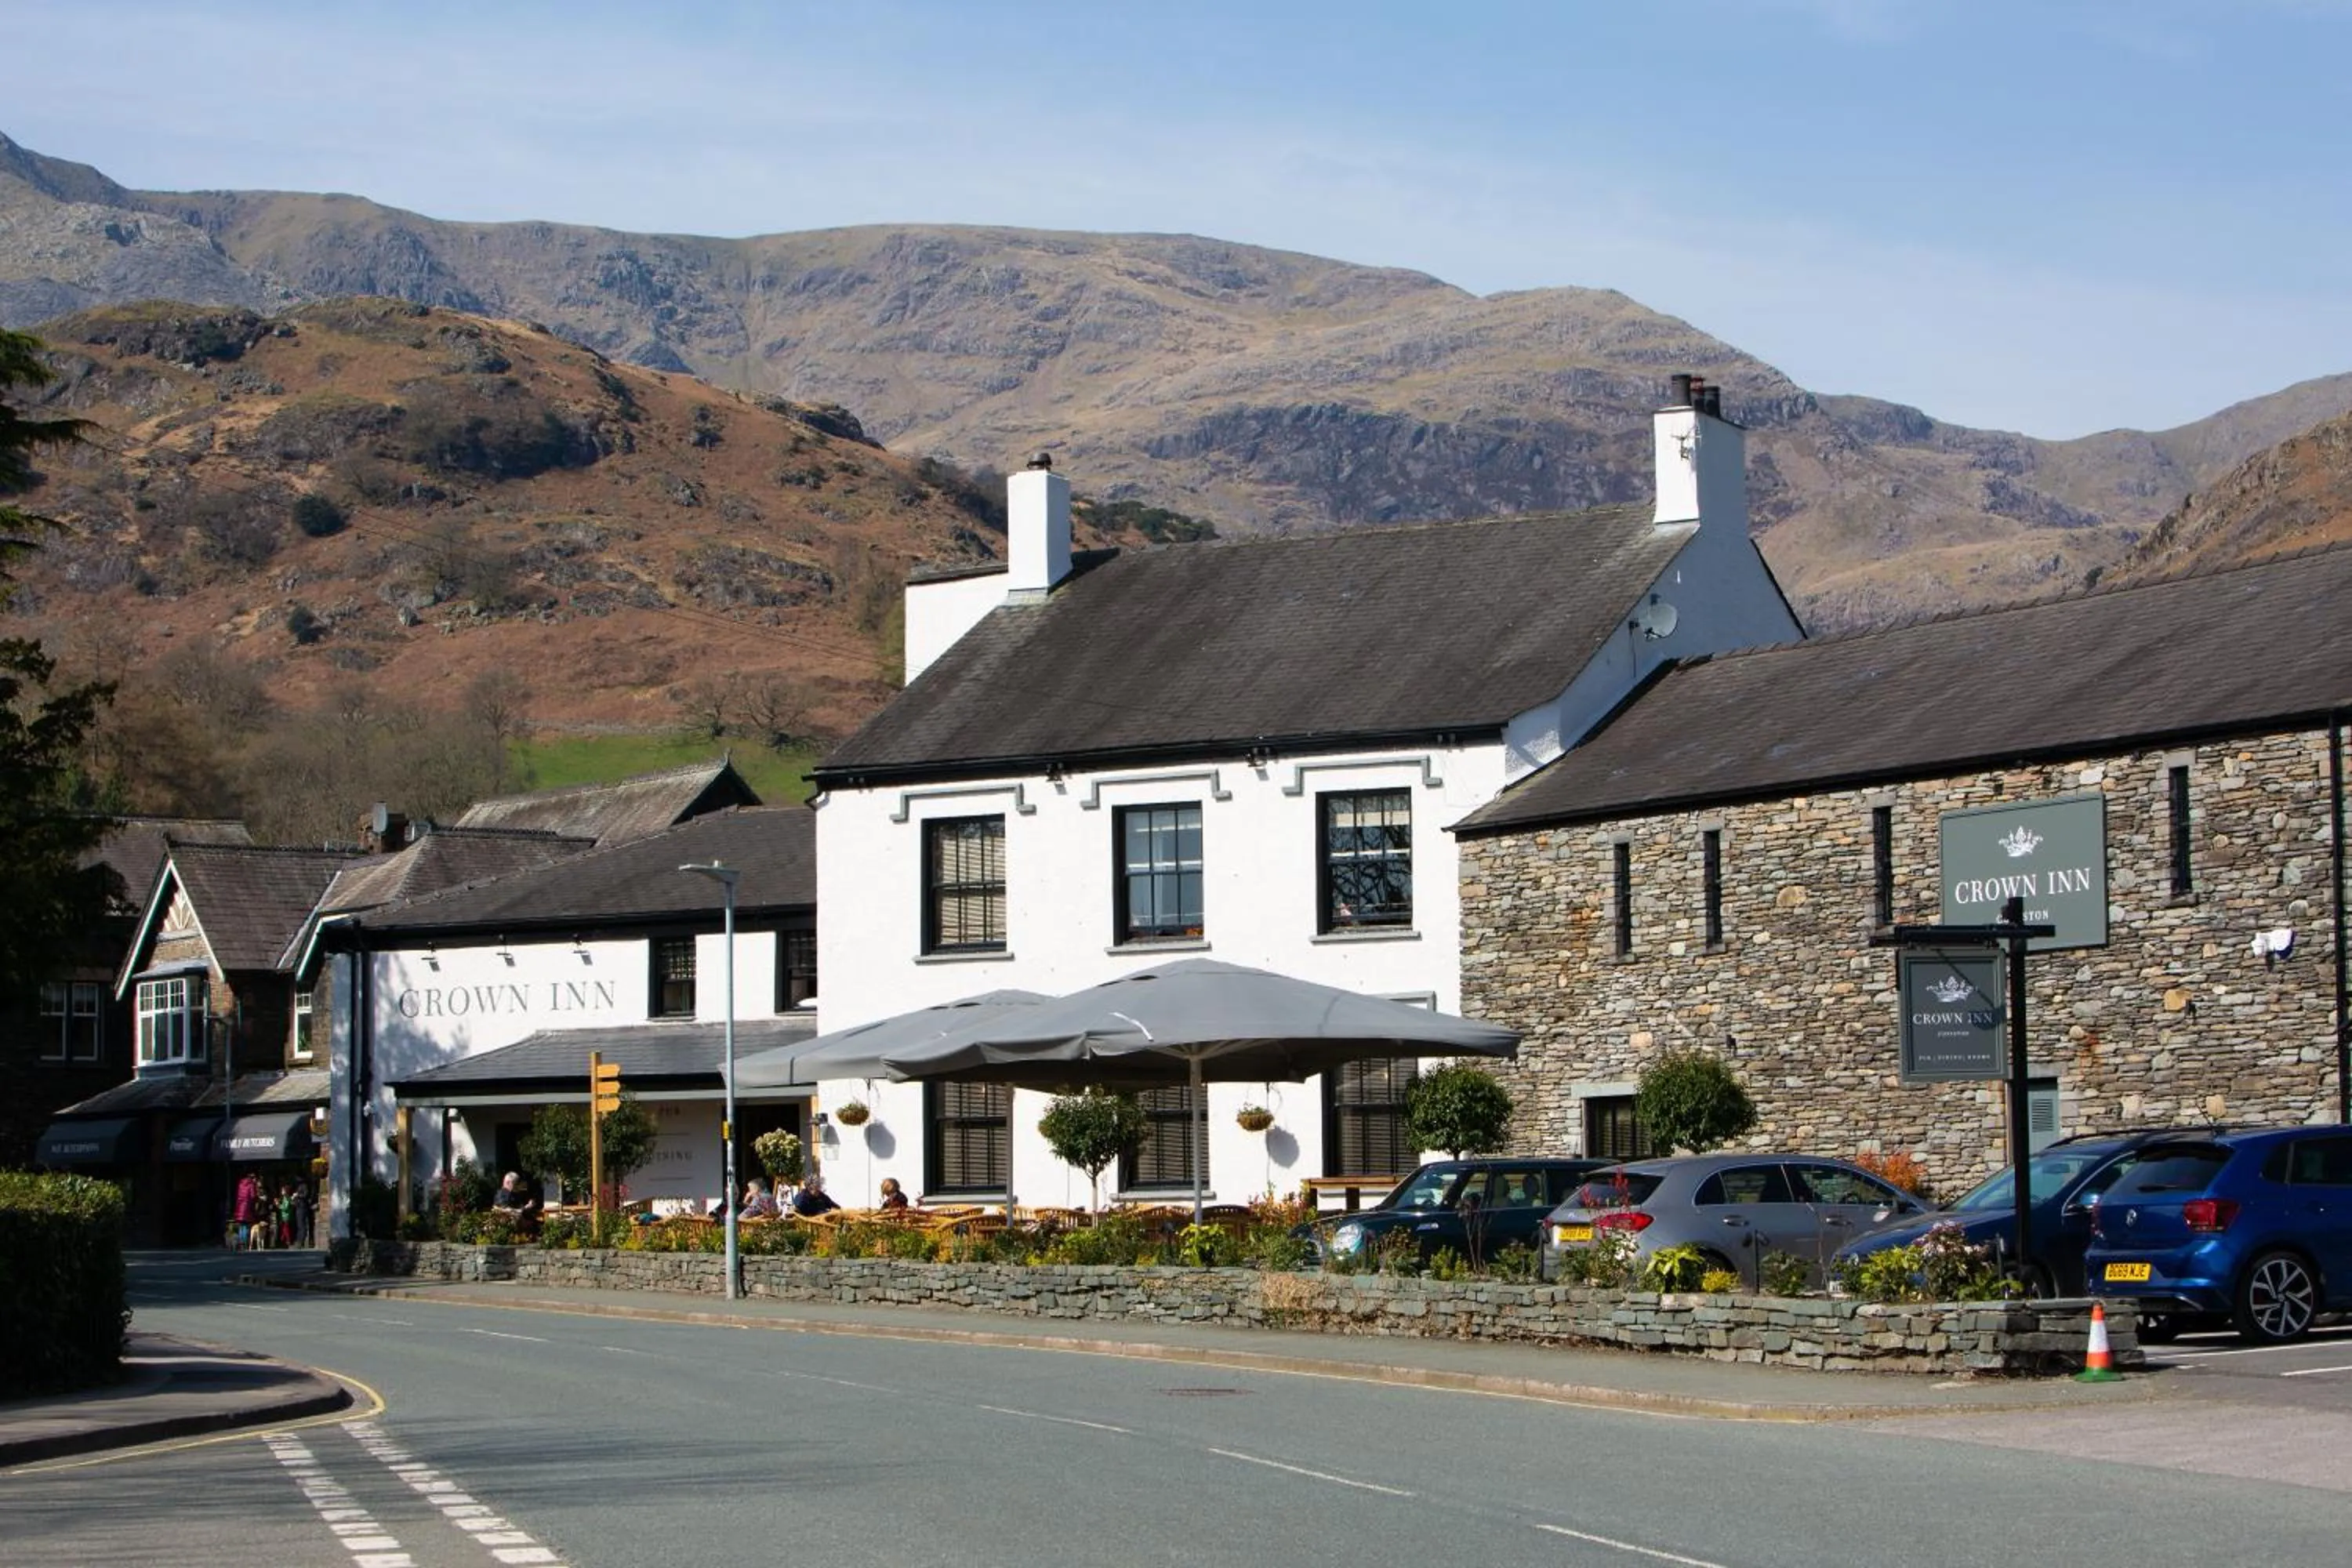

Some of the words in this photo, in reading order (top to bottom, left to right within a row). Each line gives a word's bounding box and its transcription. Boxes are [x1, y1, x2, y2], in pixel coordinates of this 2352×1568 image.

[1955, 873, 2037, 904] CROWN
[2047, 867, 2091, 895] INN
[1995, 909, 2049, 924] CSTON
[399, 984, 530, 1018] CROWN
[550, 980, 615, 1011] INN
[1912, 1012, 1963, 1025] CROWN
[1967, 1011, 1993, 1023] INN
